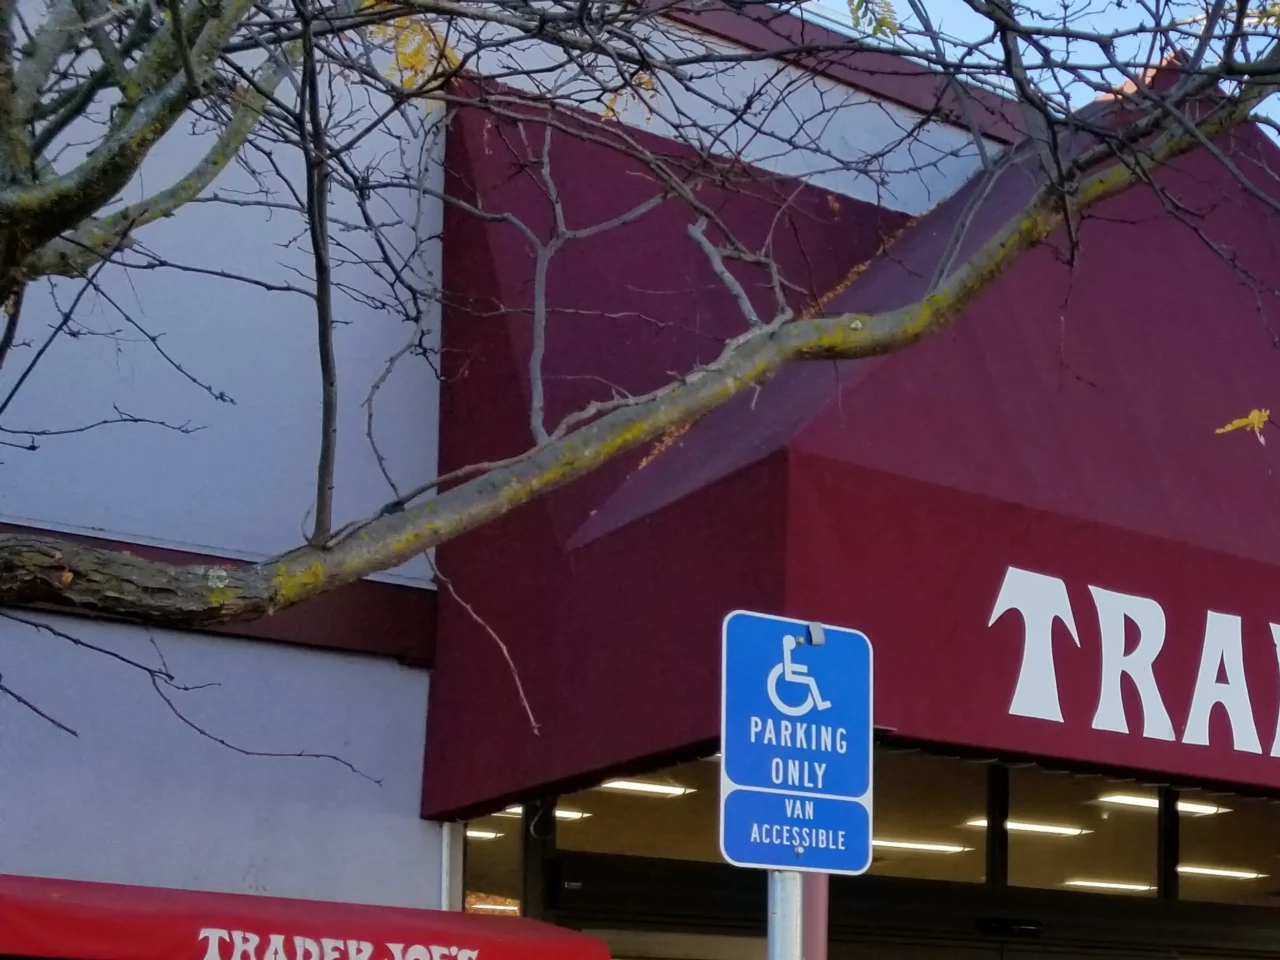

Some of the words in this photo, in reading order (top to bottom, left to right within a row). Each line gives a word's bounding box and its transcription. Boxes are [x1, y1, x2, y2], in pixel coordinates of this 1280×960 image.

[750, 716, 847, 754] PARKING
[771, 758, 827, 788] ONLY
[785, 799, 813, 820] VAN
[750, 823, 846, 850] ACCESSIBLE
